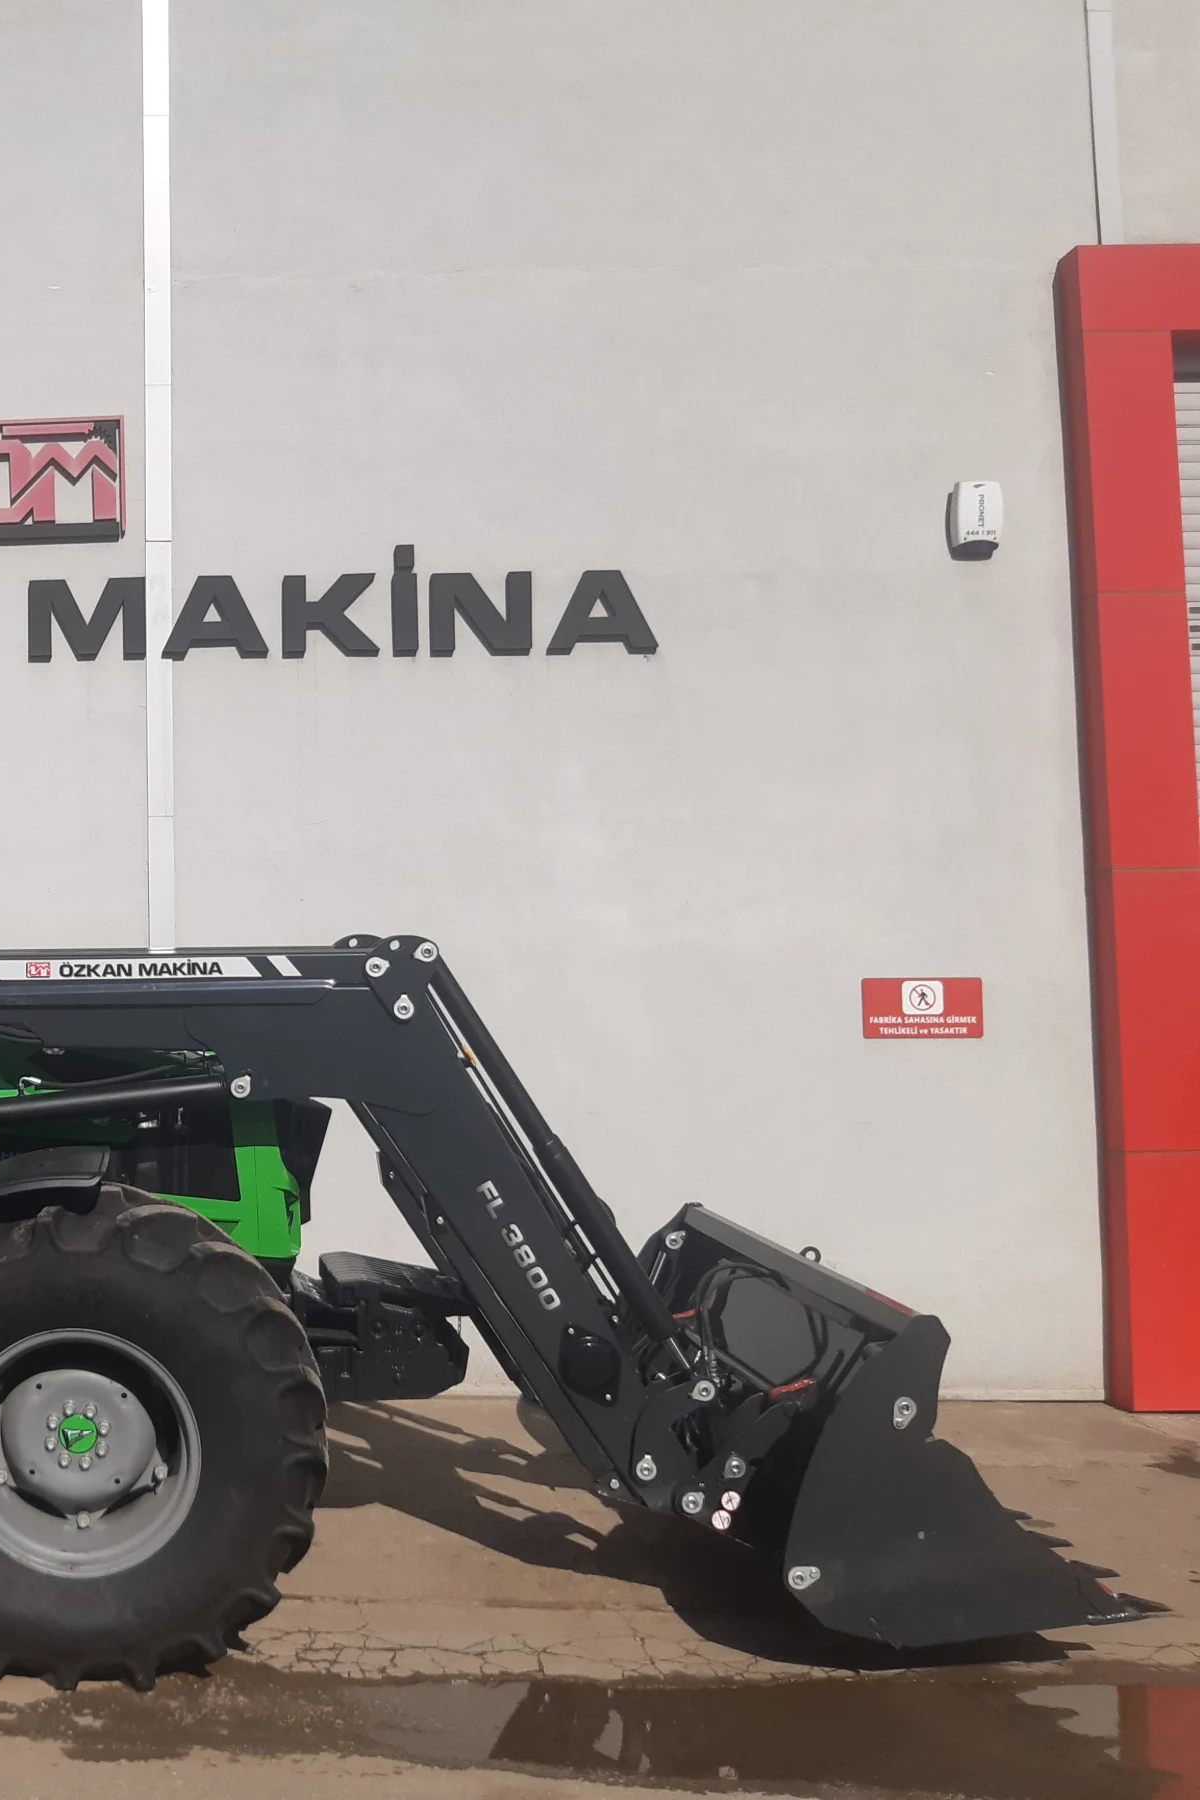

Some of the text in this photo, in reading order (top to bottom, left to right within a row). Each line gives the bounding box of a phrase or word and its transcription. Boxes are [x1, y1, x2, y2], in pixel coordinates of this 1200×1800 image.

[977, 493, 985, 527] PRONET
[28, 544, 659, 662] MAKİNA
[59, 961, 133, 978] ÖZKAN
[138, 959, 224, 977] MAKİNA
[869, 1015, 977, 1024] FABRİKA SAHASINA GİRMEK
[879, 1026, 918, 1035] TEHLİKELİ
[930, 1027, 968, 1035] YASAKTIR
[475, 1180, 561, 1311] FL 3800
